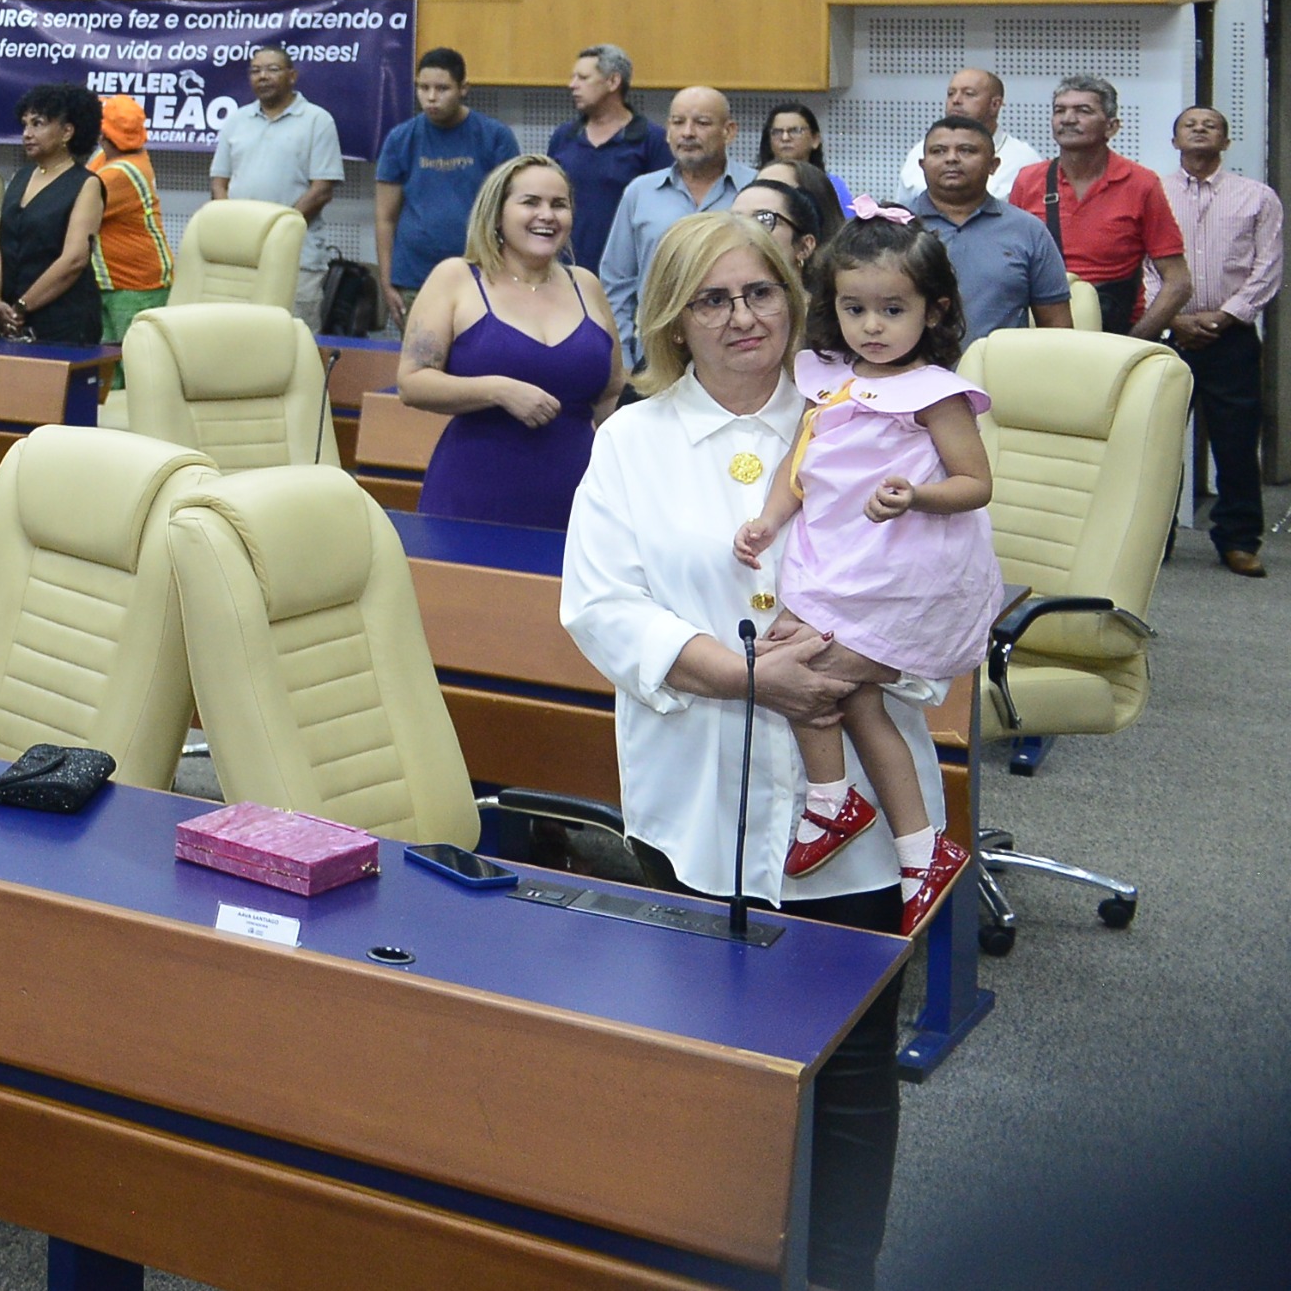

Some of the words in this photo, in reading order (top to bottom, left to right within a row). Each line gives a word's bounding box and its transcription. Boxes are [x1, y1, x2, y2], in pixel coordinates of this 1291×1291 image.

[43, 11, 123, 34] sempre
[128, 9, 160, 29] fez
[164, 13, 179, 29] e
[184, 9, 283, 29] continua
[288, 8, 384, 29] fazendo
[389, 13, 407, 30] a
[81, 44, 110, 60] na
[116, 40, 163, 60] vida
[168, 41, 208, 61] dos
[87, 71, 178, 93] HEYLER
[187, 131, 196, 143] E
